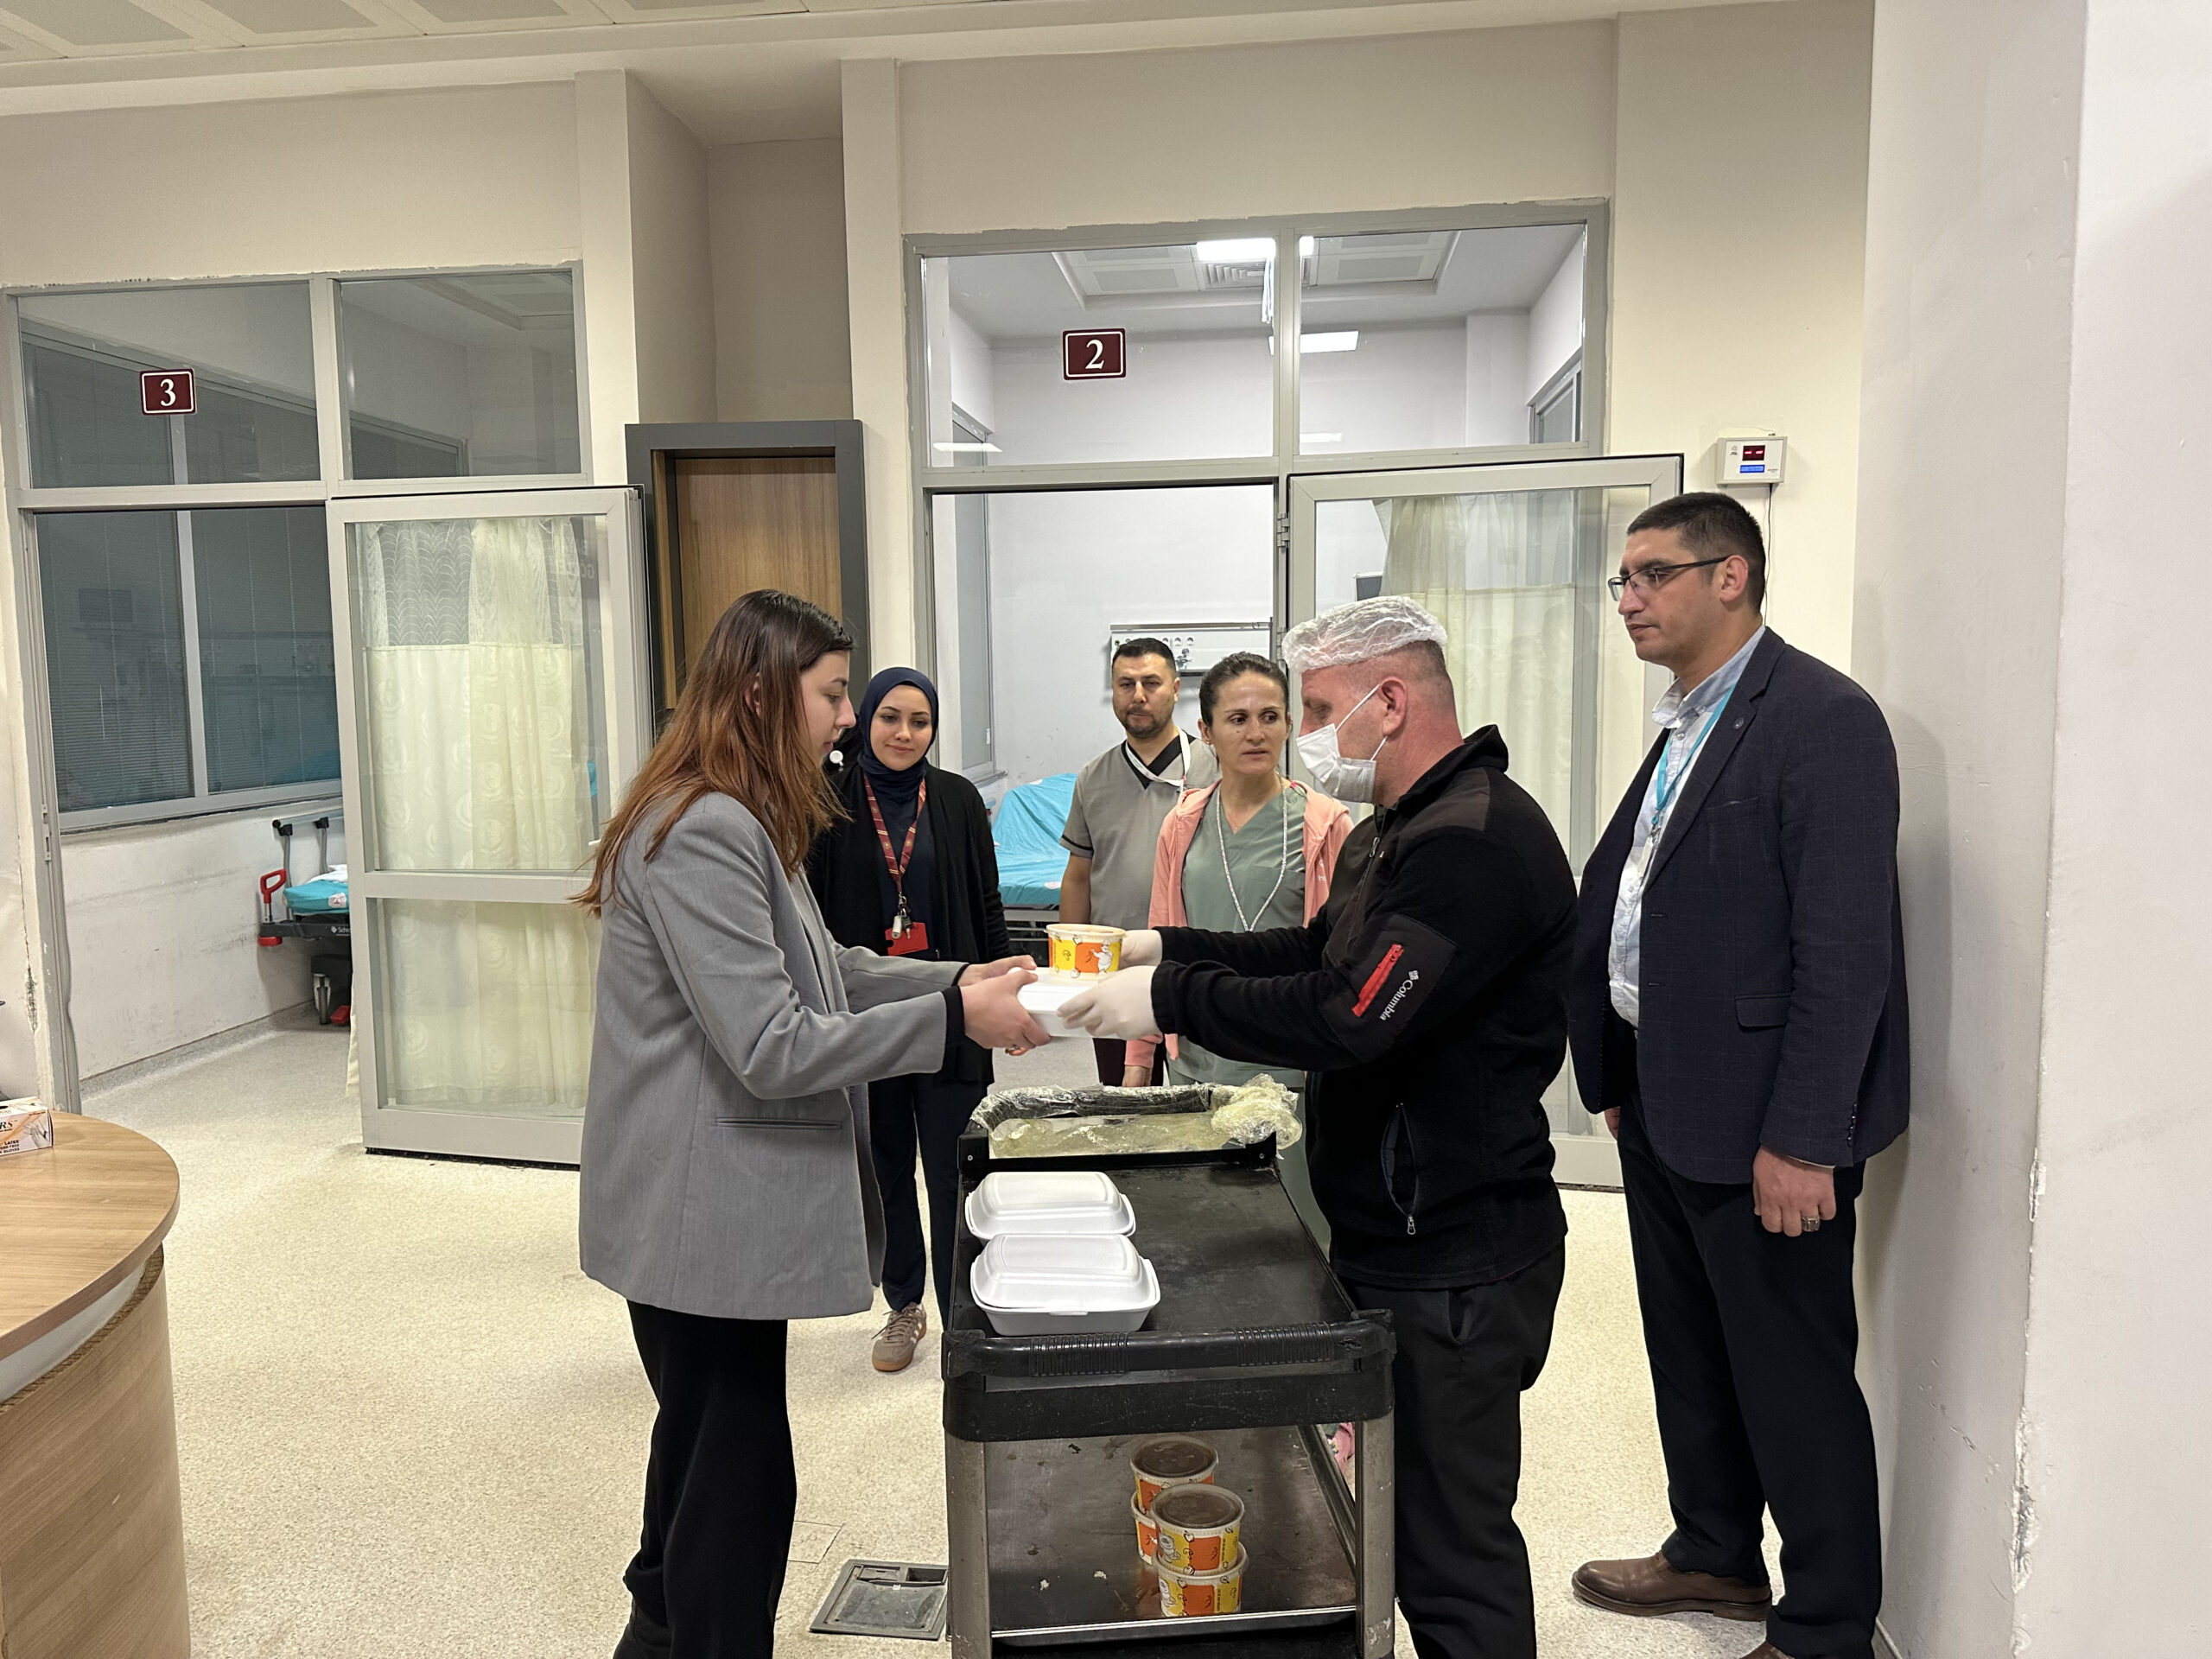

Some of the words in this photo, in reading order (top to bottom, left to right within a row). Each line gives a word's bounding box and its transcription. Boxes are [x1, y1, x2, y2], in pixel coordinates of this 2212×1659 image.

[1085, 339, 1104, 370] 2
[160, 378, 176, 407] 3
[1379, 979, 1414, 1021] Columbia
